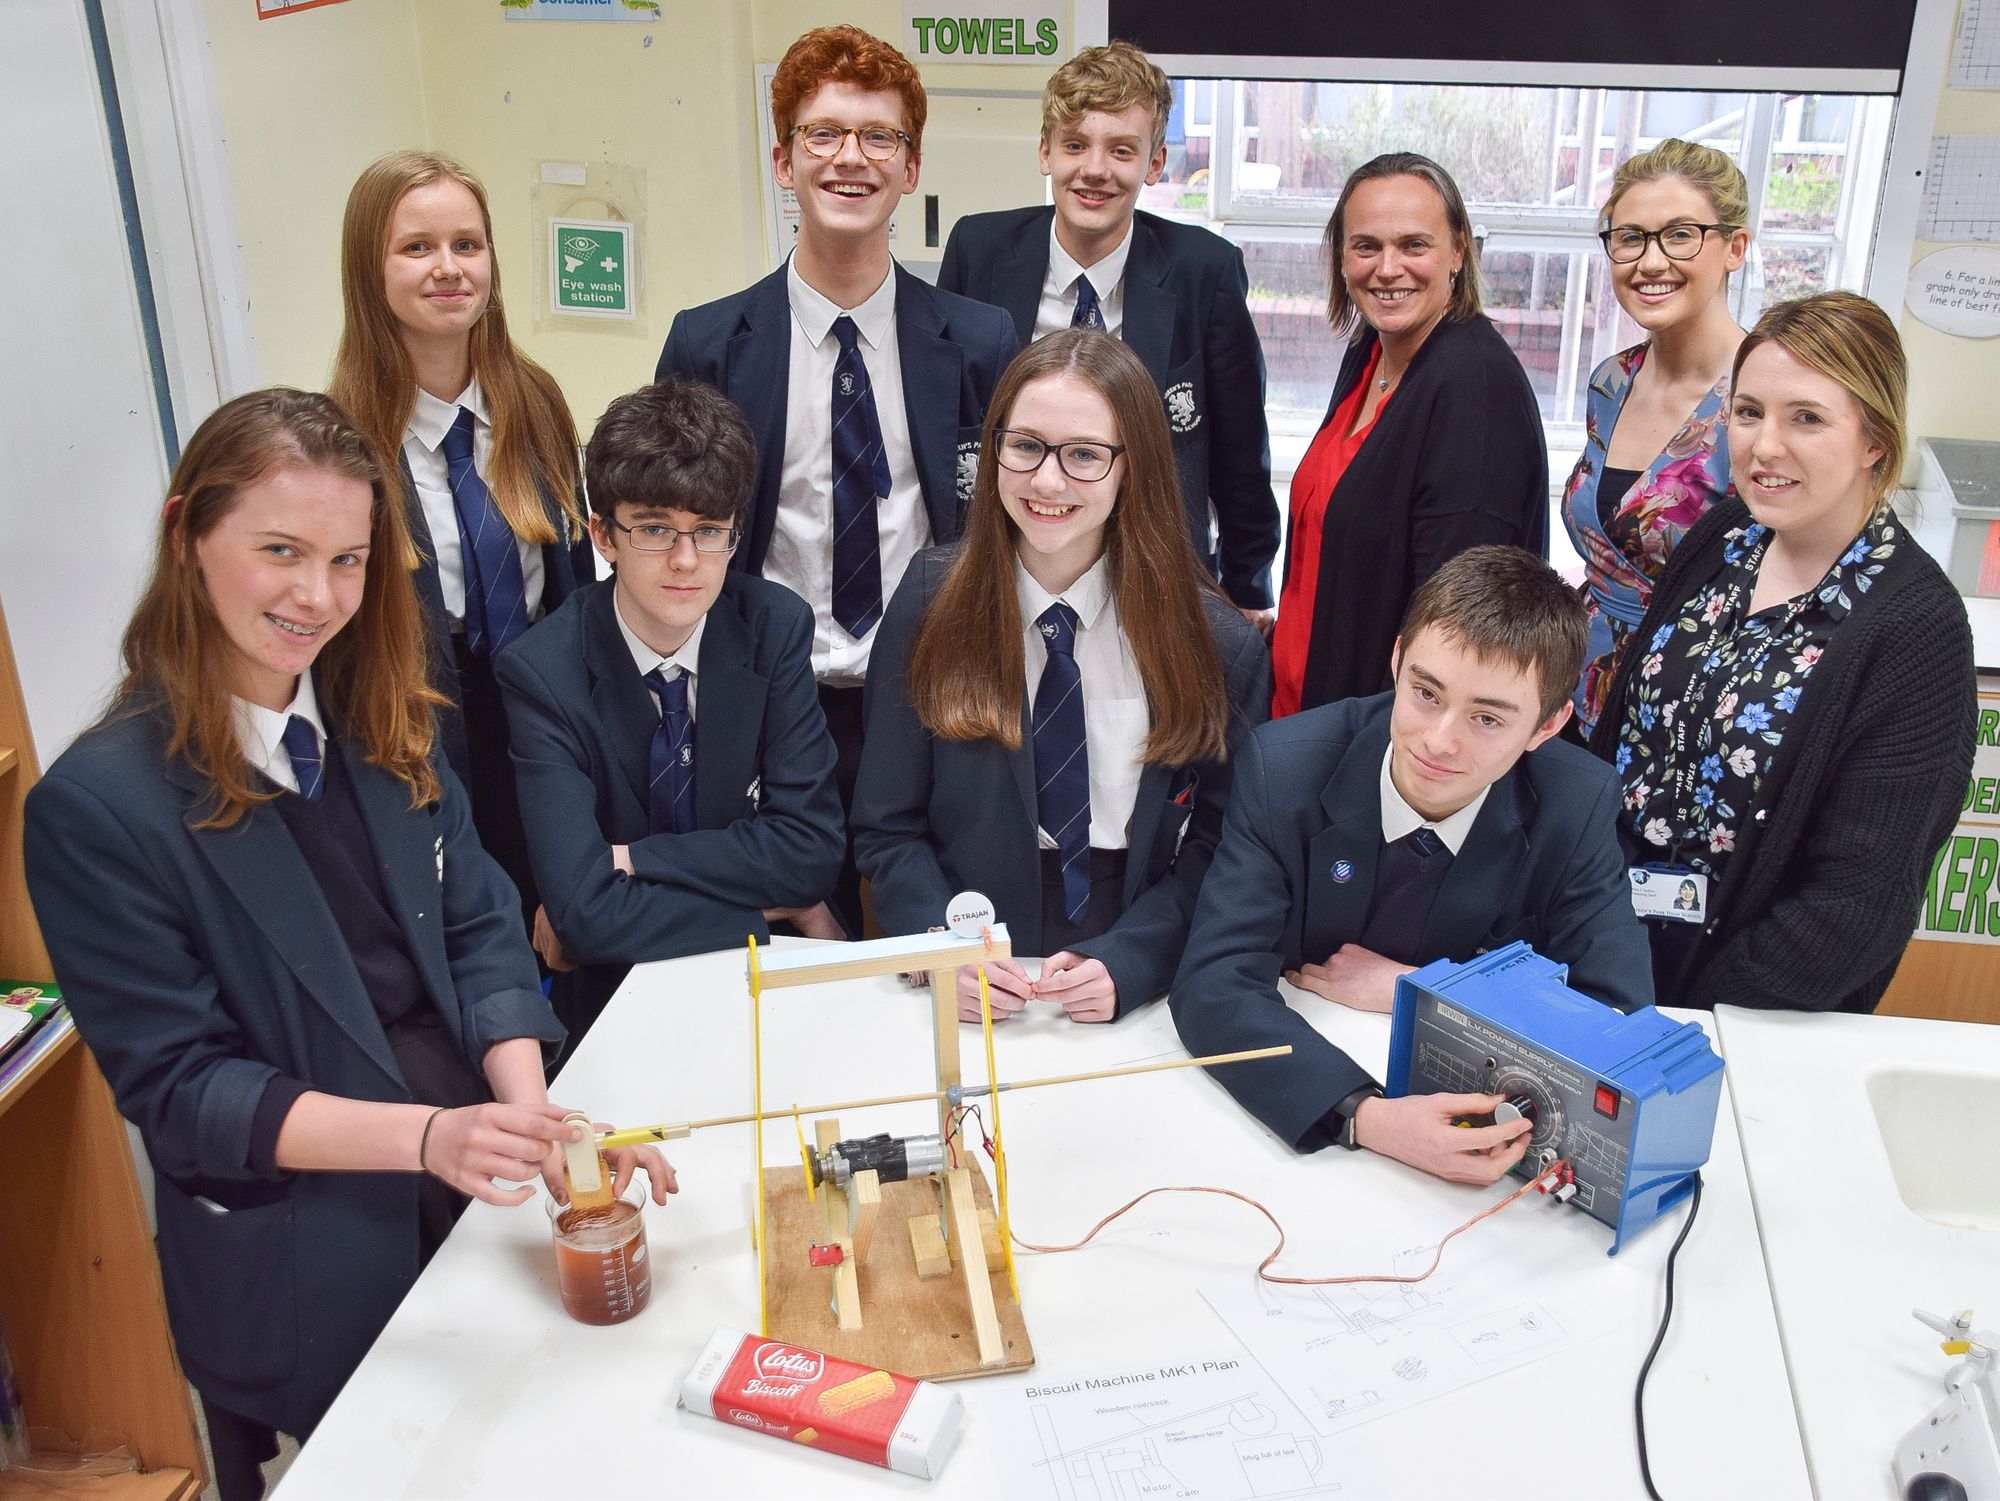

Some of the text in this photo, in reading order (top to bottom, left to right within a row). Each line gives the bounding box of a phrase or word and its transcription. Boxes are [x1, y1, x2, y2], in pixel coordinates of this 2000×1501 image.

[912, 17, 1058, 55] TOWELS
[562, 279, 622, 292] Eye wash
[1945, 270, 1954, 280] 6.
[1958, 272, 1976, 282] For
[571, 292, 614, 303] station
[1925, 283, 1956, 295] graph
[1959, 287, 1980, 299] only
[1929, 295, 1948, 306] line
[1951, 299, 1963, 308] of
[1965, 300, 1989, 312] best
[1745, 543, 1765, 571] STAFF
[1723, 585, 1741, 613] STAFF
[1701, 629, 1719, 657] STAFF
[1750, 636, 1773, 663] STAFF
[1683, 673, 1698, 702] STAFF
[1717, 675, 1739, 702] STAFF
[1677, 720, 1686, 752] STAFF
[1976, 709, 2000, 747] R
[1684, 762, 1697, 793] STAFF
[961, 909, 989, 920] TRAJAN
[1438, 1004, 1467, 1026] IRWIN
[1482, 1028, 1518, 1051] POWER
[1518, 1045, 1555, 1068] SUPPLY
[763, 1348, 818, 1372] Lotus
[742, 1379, 804, 1397] Biscoff
[1026, 1359, 1240, 1398] Biscuit Machine MK1 Plan
[1094, 1399, 1170, 1415] Wooden rod/stick
[736, 1412, 790, 1431] Lotus Biscoff
[900, 1432, 918, 1443] 250g
[1243, 1453, 1260, 1462] Mug
[1261, 1451, 1273, 1459] full
[1274, 1449, 1282, 1457] of
[1142, 1483, 1200, 1498] Motor Cam
